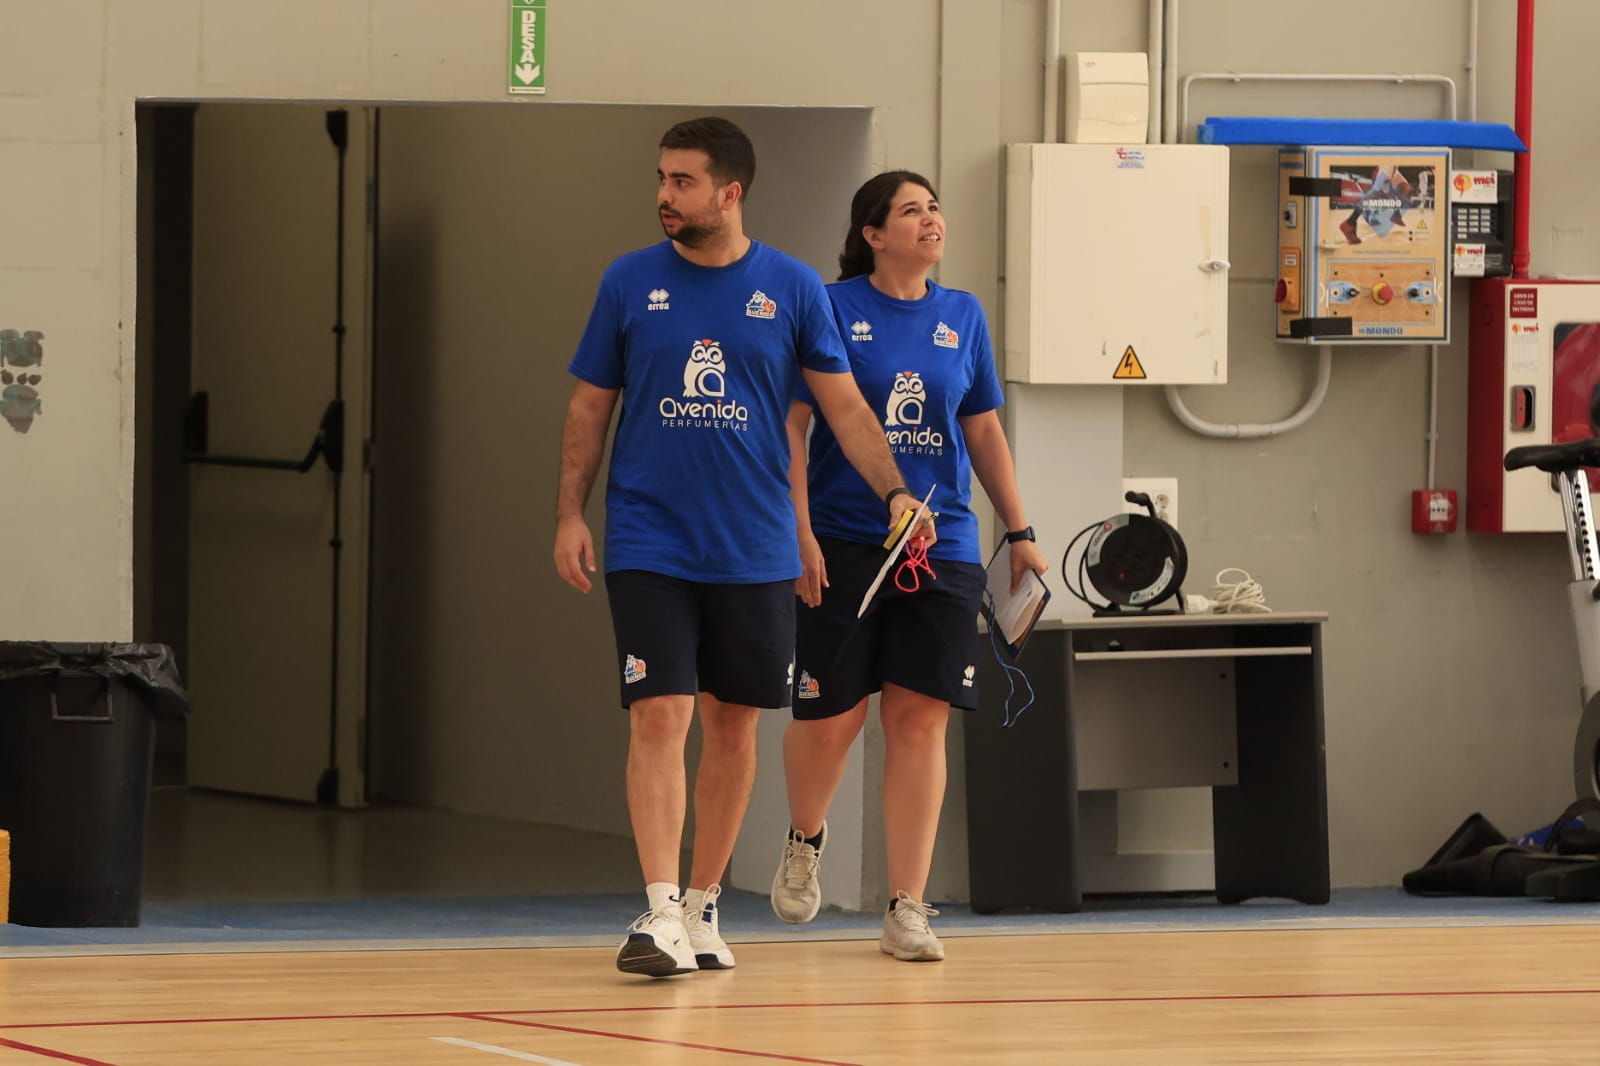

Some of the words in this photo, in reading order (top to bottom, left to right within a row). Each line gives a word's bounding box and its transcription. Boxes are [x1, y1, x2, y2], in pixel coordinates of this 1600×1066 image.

[520, 10, 536, 63] DESA
[1369, 198, 1402, 207] MONDO
[1366, 327, 1403, 335] MONDO
[886, 426, 943, 447] enida
